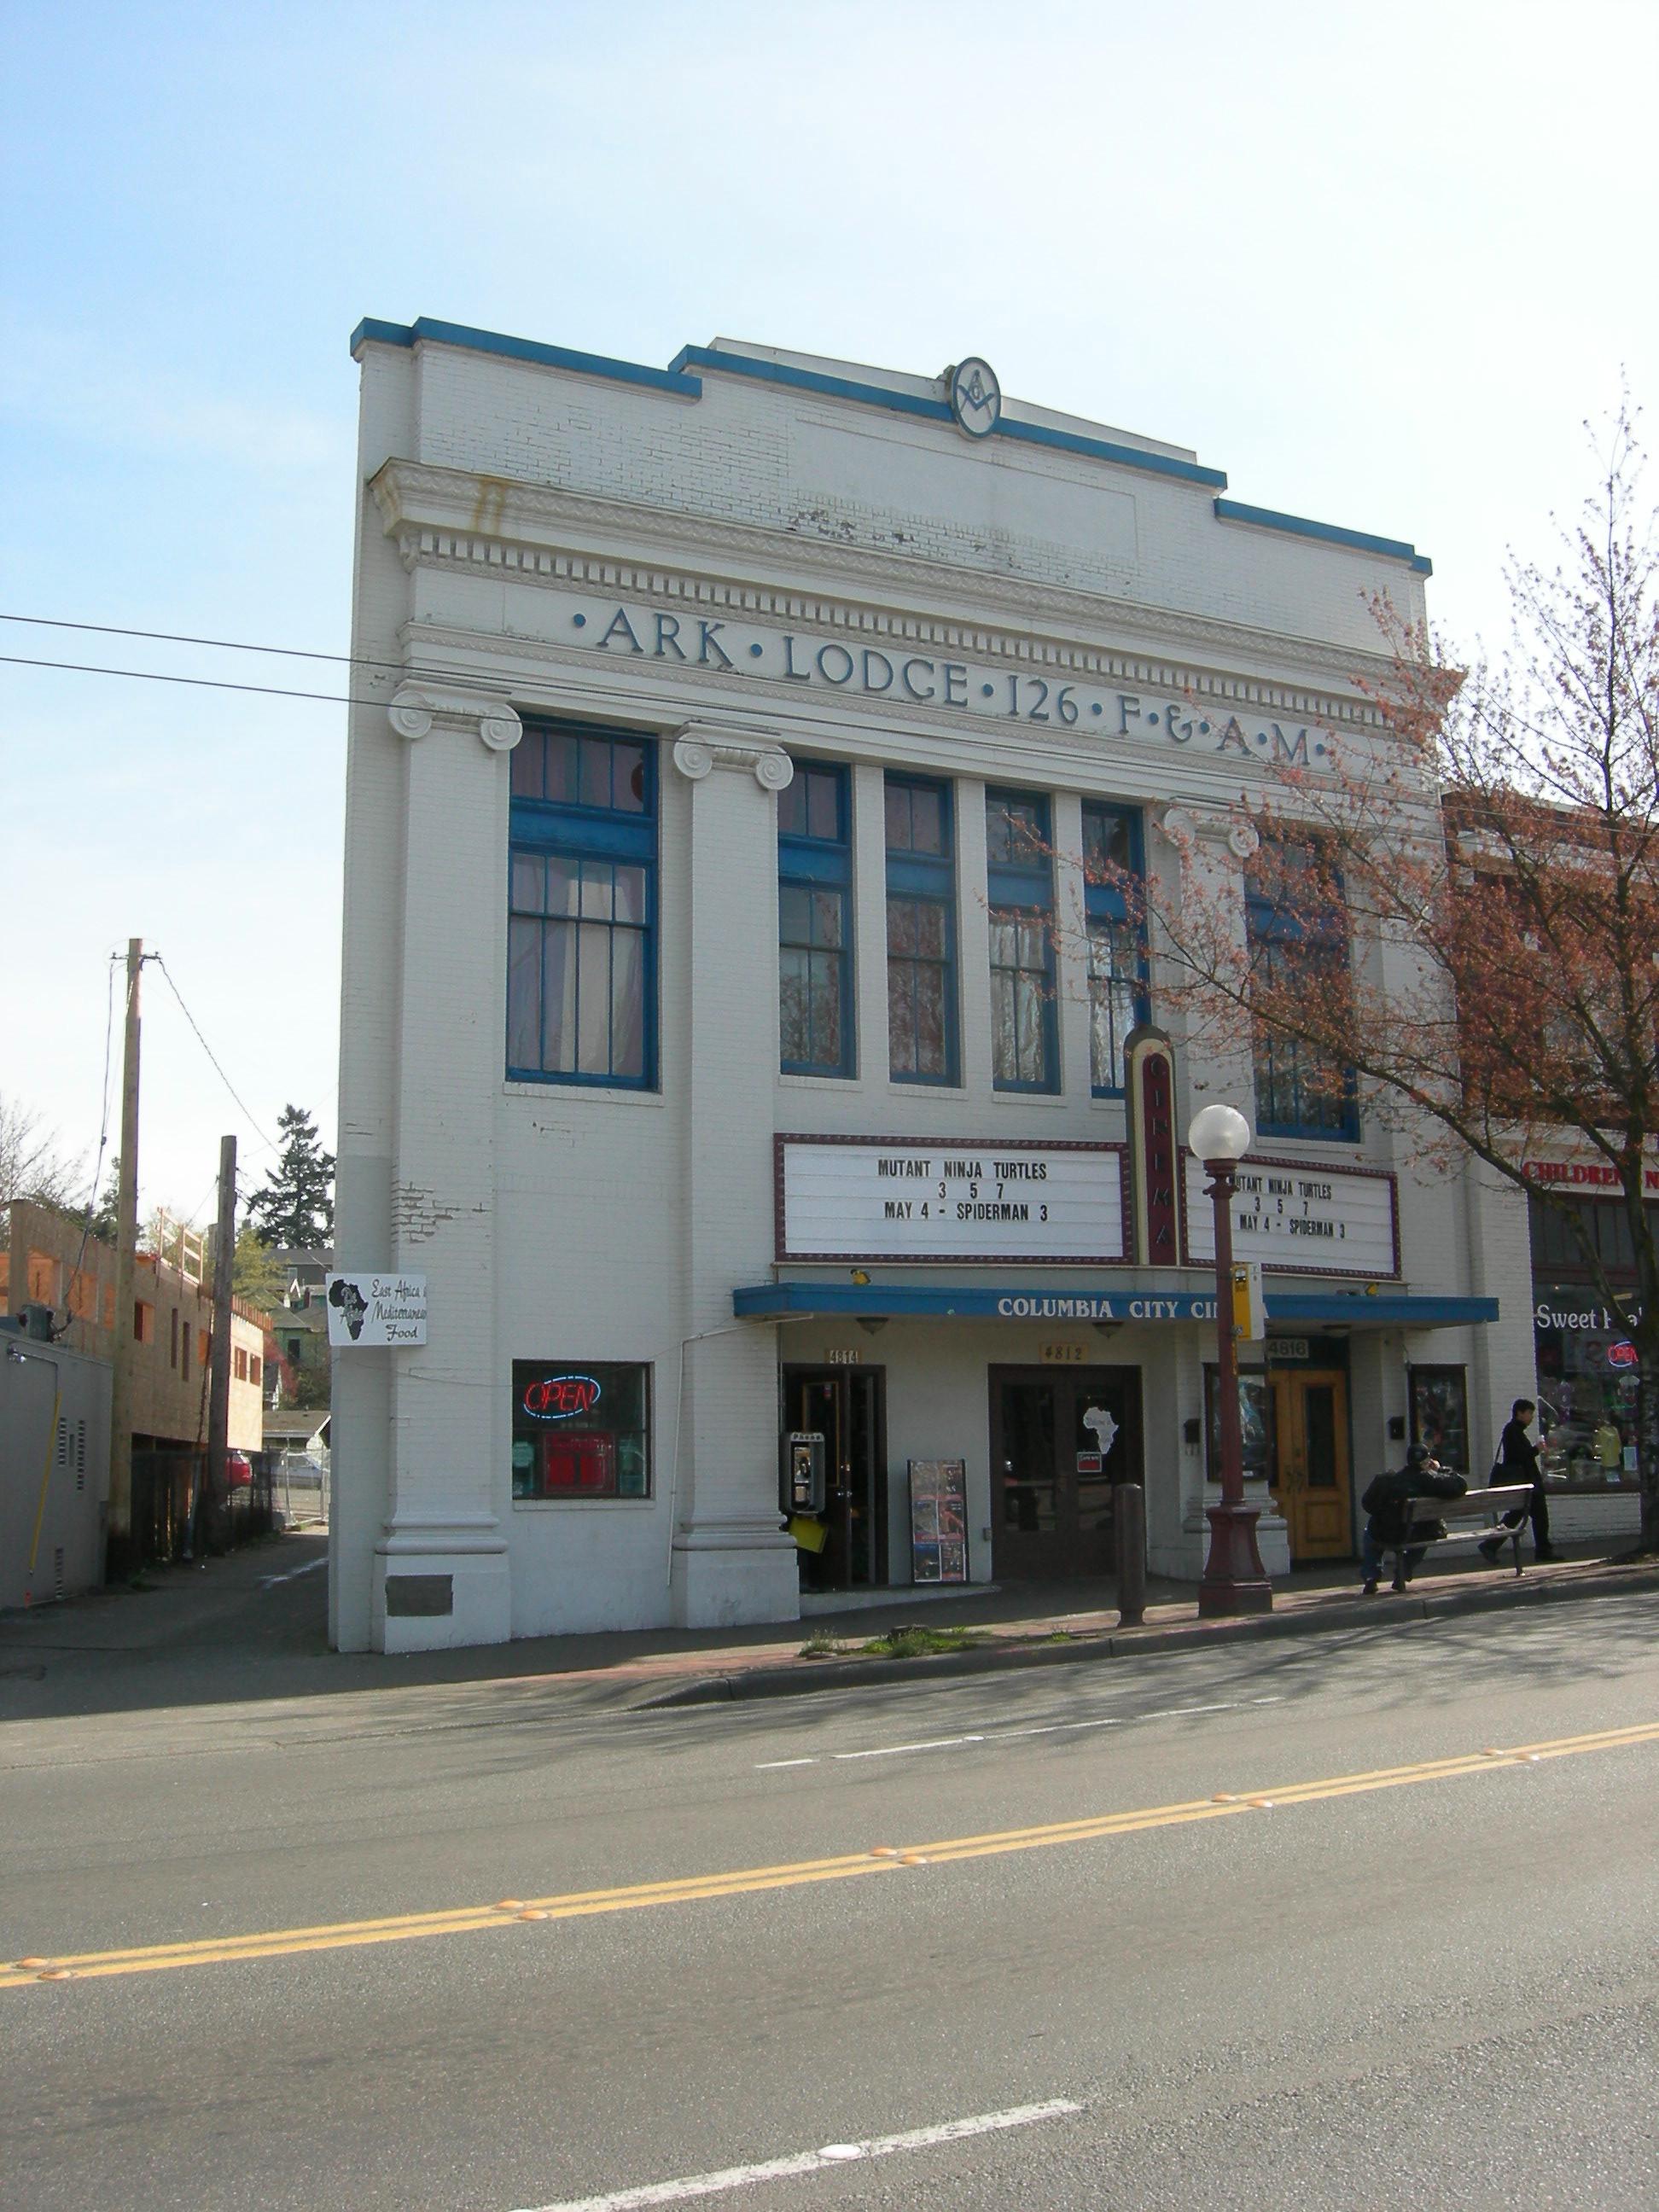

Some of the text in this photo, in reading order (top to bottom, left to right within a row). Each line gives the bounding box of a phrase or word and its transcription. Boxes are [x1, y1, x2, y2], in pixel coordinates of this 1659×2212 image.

[597, 607, 734, 669] ARK
[783, 635, 969, 707] LODGE
[1007, 674, 1080, 725] 126
[878, 1159, 1048, 1180] MUTANT NINJA TURTLES
[939, 1182, 1004, 1200] 3 5 7
[1268, 1179, 1294, 1196] NINJA
[1298, 1181, 1332, 1200] TURTLES
[885, 1202, 913, 1220] MAY
[921, 1202, 929, 1220] 4
[957, 1202, 1029, 1221] SPIDERMAN
[1039, 1204, 1048, 1222] 3
[1254, 1196, 1309, 1216] 3 5 7
[1239, 1214, 1258, 1231] MAY
[1263, 1216, 1270, 1231] 4
[1289, 1219, 1334, 1237] SPIDERMAN
[1339, 1223, 1346, 1239] 3
[998, 1297, 1114, 1318] COLUMBIA
[1128, 1300, 1179, 1319] CITY
[1536, 1304, 1598, 1330] Sweet
[386, 1324, 419, 1342] Food
[1045, 1345, 1083, 1360] 4812
[523, 1380, 597, 1412] OPEN
